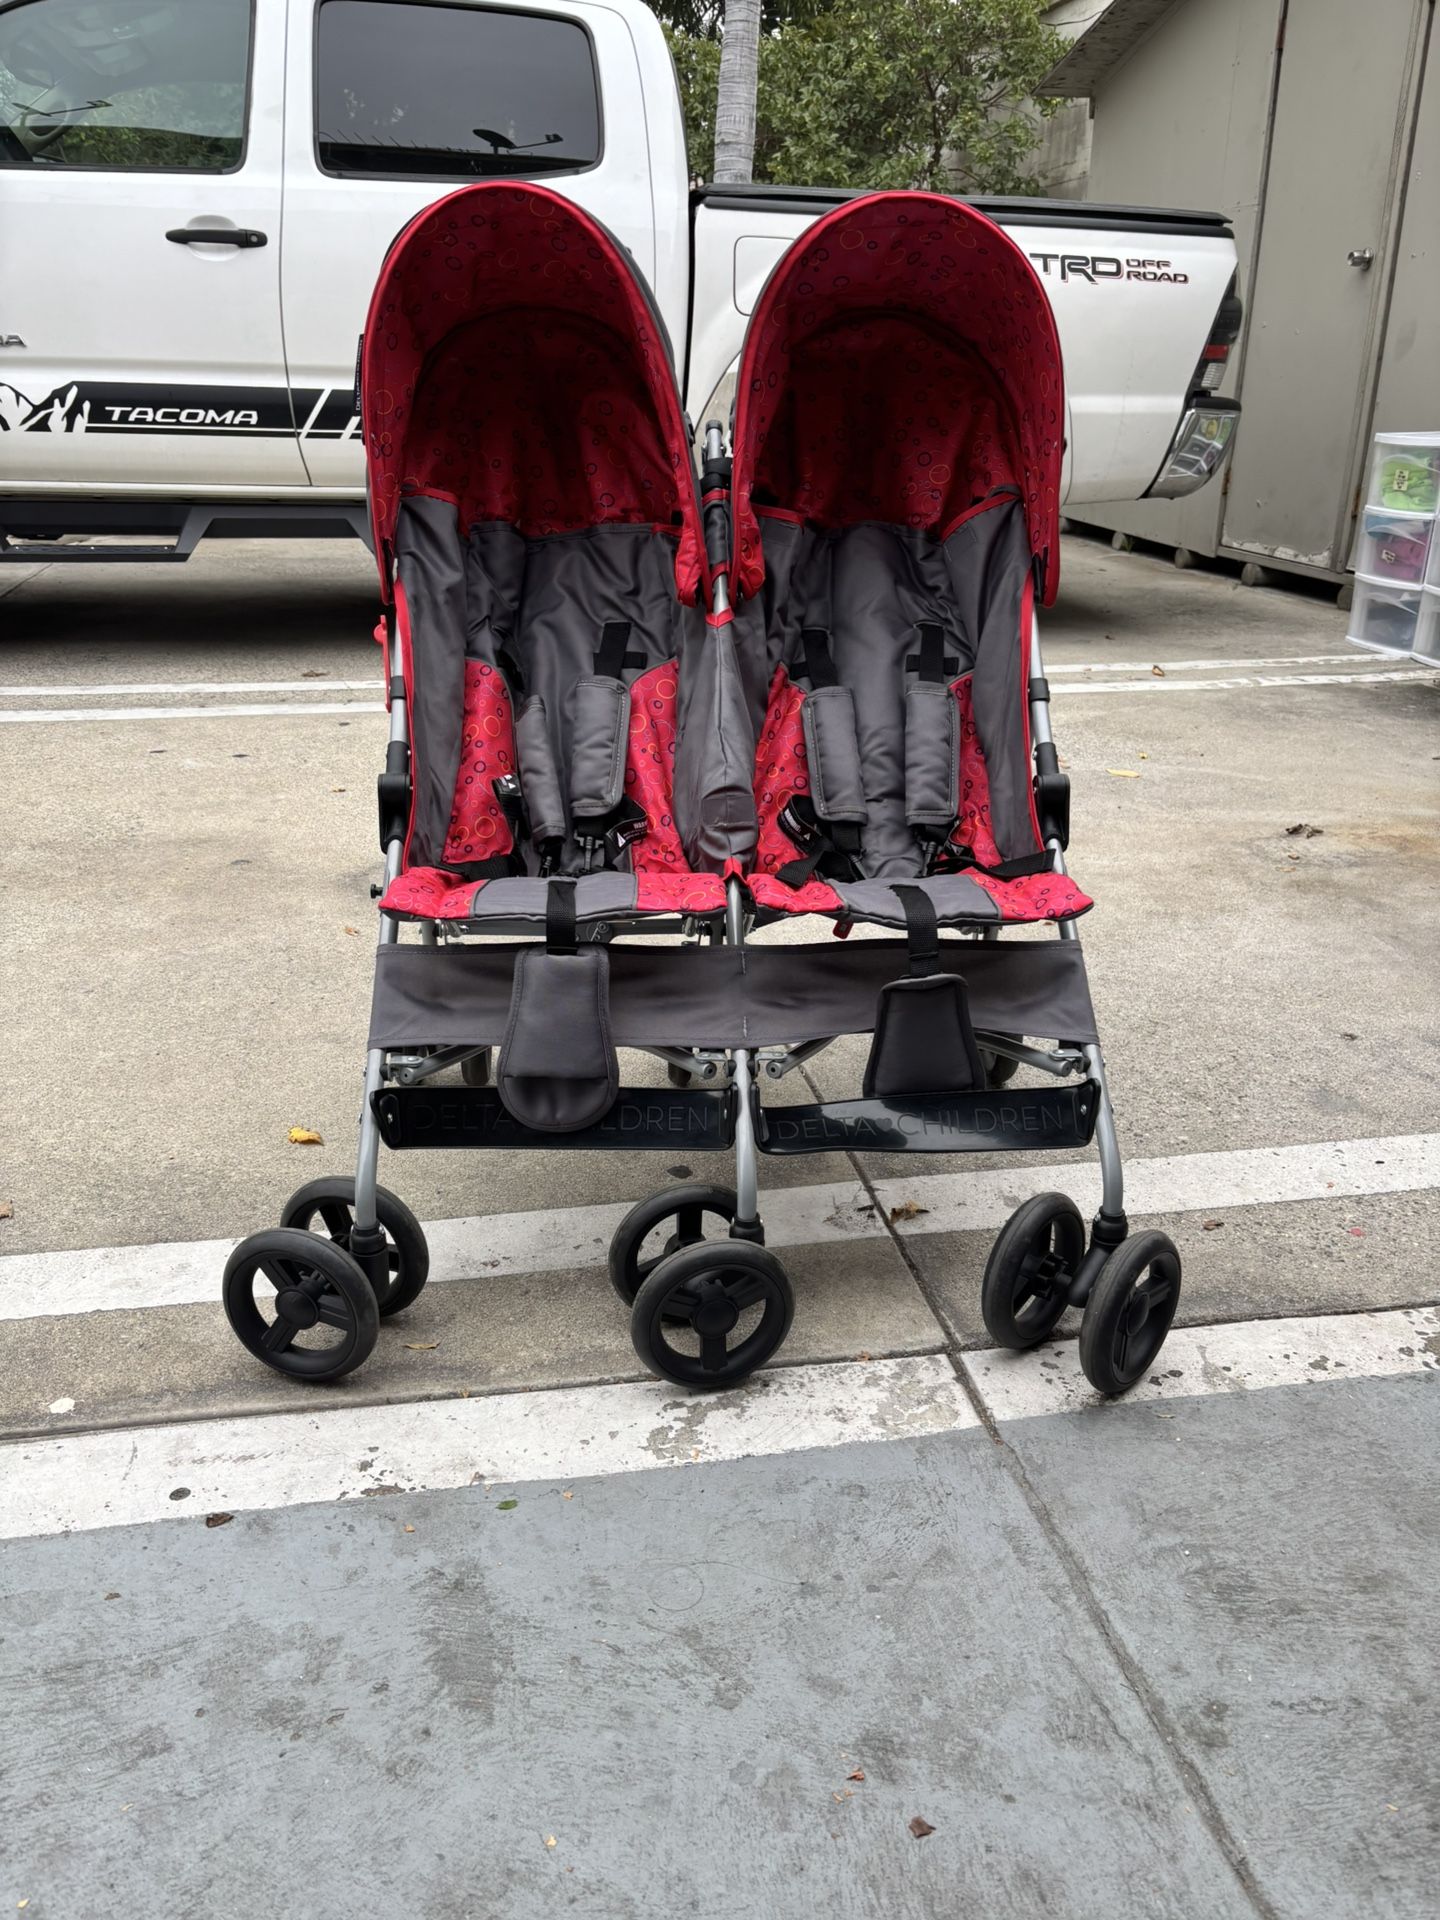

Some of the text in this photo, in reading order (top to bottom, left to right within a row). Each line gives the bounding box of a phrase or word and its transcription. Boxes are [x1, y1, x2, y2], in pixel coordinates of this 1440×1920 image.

[1029, 253, 1124, 284] TRD
[1126, 258, 1171, 269] OFF
[1126, 271, 1189, 284] ROAD
[0, 334, 27, 348] A
[105, 406, 259, 425] TACOMA
[411, 1103, 708, 1131] DELTA LDREN
[776, 1105, 1064, 1140] DELTA CHILDREN
